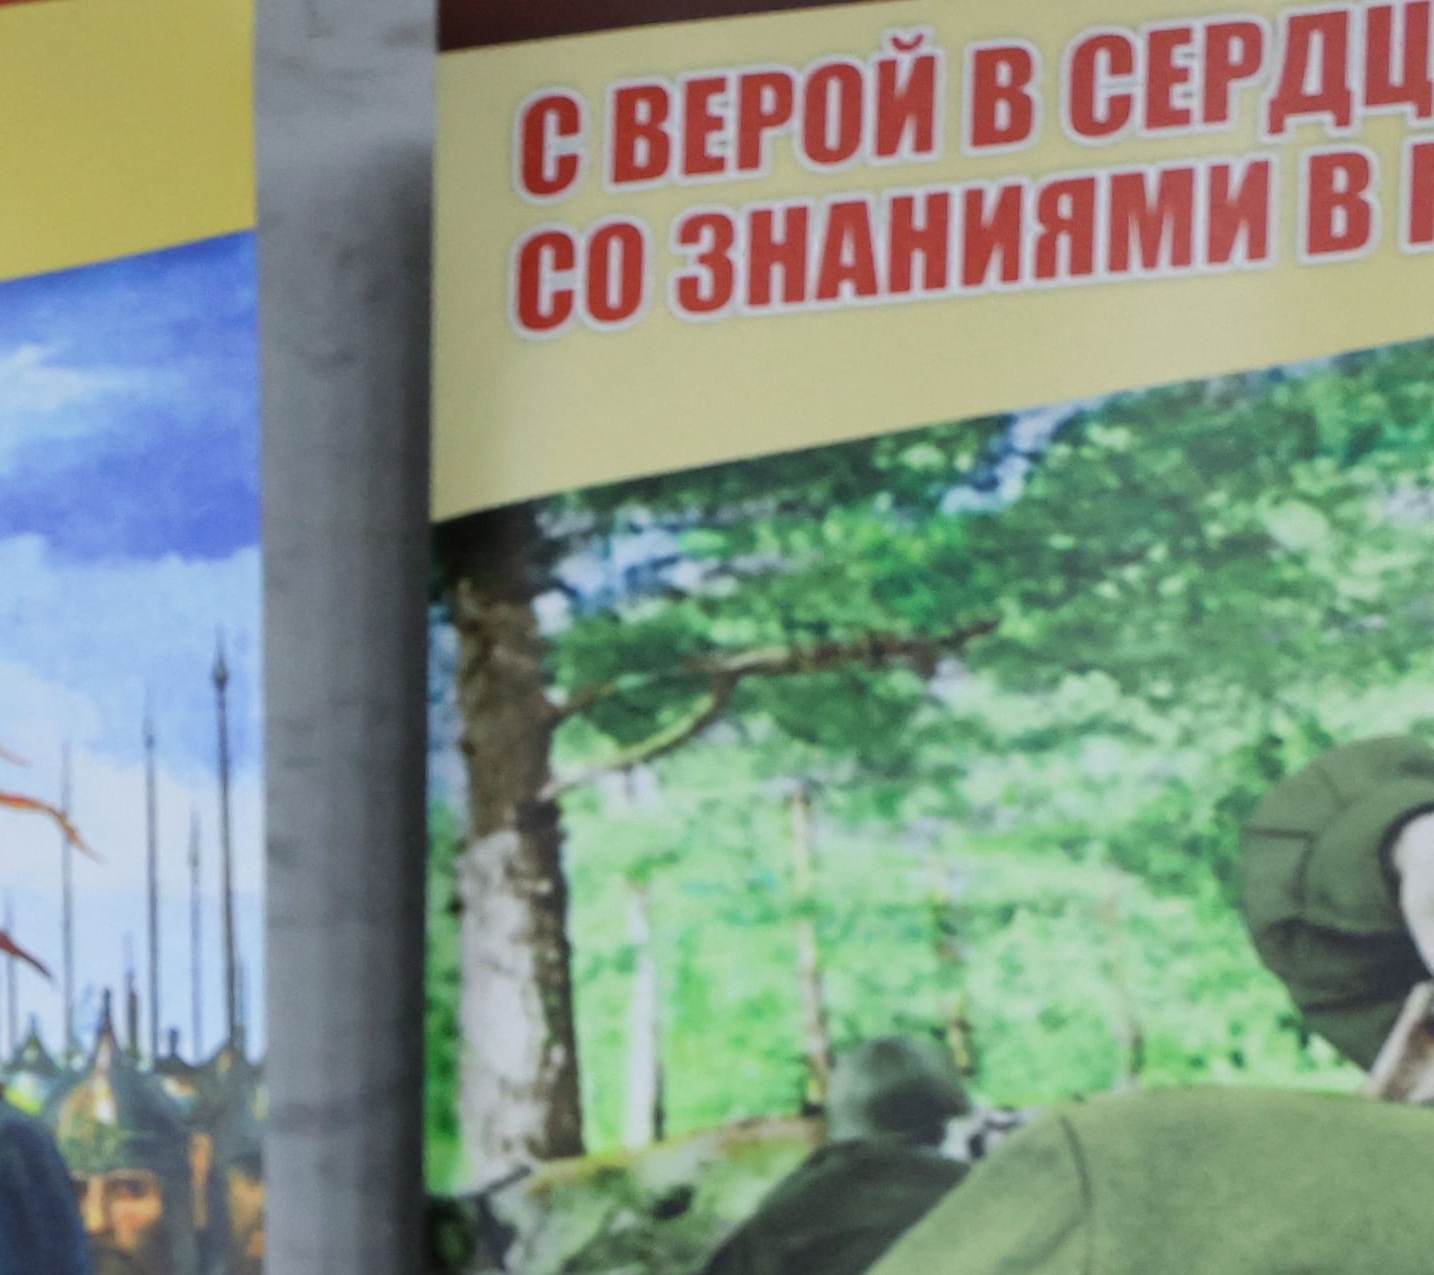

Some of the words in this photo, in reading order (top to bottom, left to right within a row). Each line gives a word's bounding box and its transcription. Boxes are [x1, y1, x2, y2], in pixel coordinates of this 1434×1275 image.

[522, 94, 581, 197] С
[613, 32, 937, 184] ВЕРОЙ
[971, 46, 1034, 148] В
[1070, 2, 1434, 137] СЕРДЦ
[518, 222, 645, 332] СО
[677, 161, 1271, 314] ЗНАНИЯМИ
[1307, 151, 1371, 257] В
